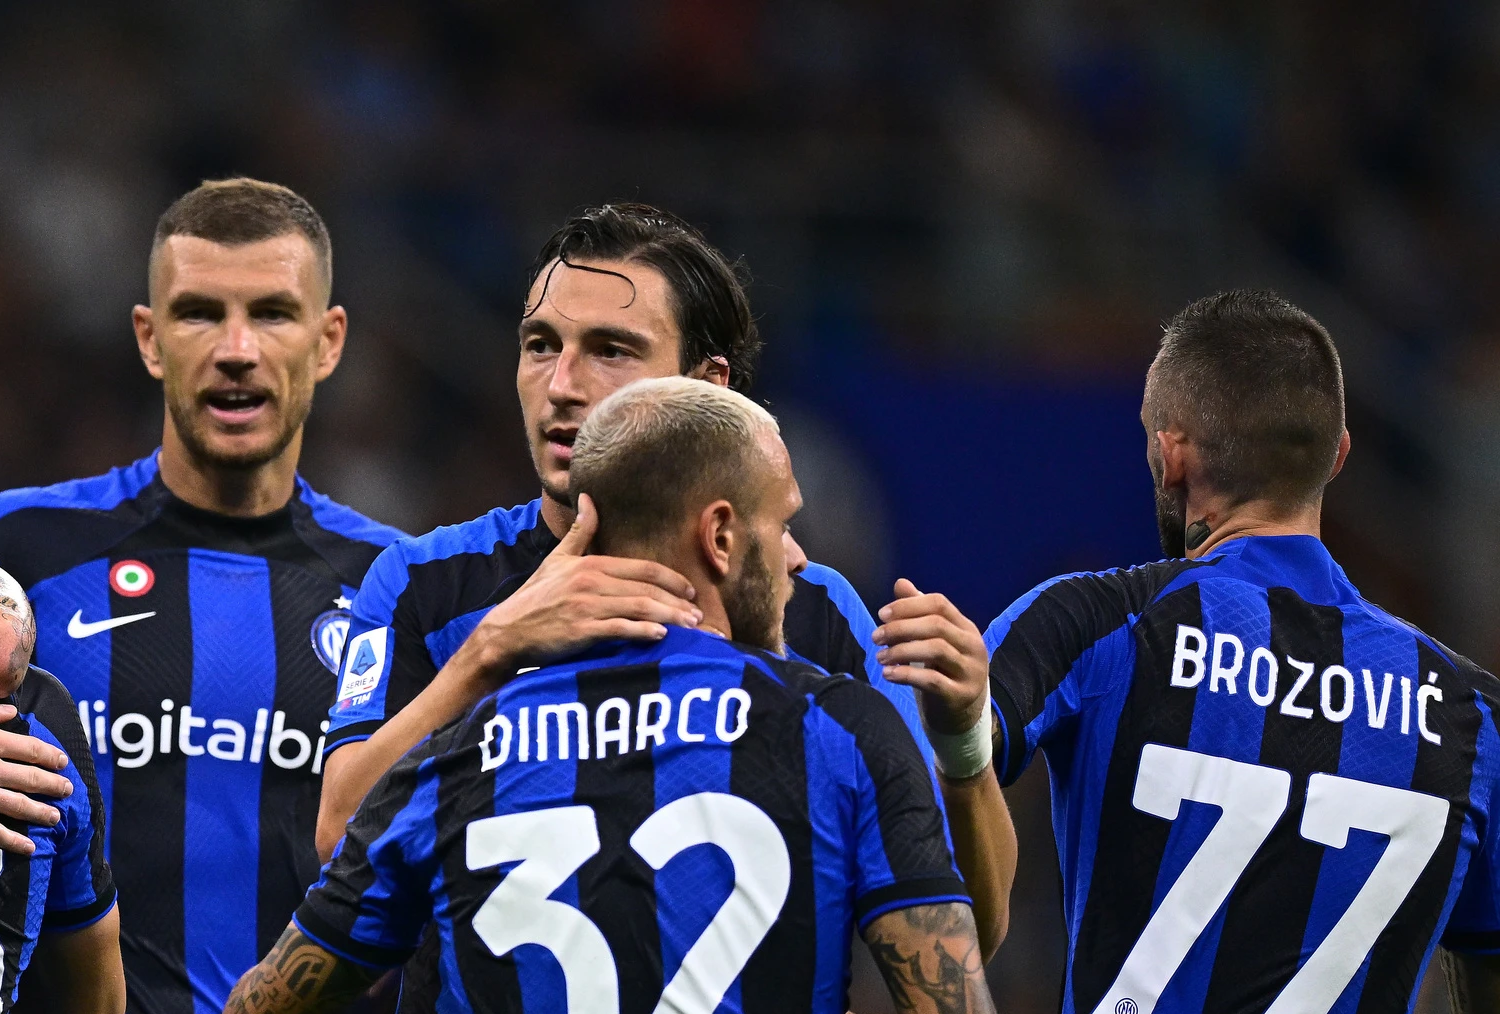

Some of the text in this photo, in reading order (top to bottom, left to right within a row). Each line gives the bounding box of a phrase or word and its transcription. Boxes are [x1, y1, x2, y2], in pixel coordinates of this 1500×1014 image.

[345, 677, 368, 691] SERIE
[352, 692, 372, 706] TIM
[1170, 624, 1443, 745] BROZOVIĆ
[478, 687, 752, 773] DIMARCO
